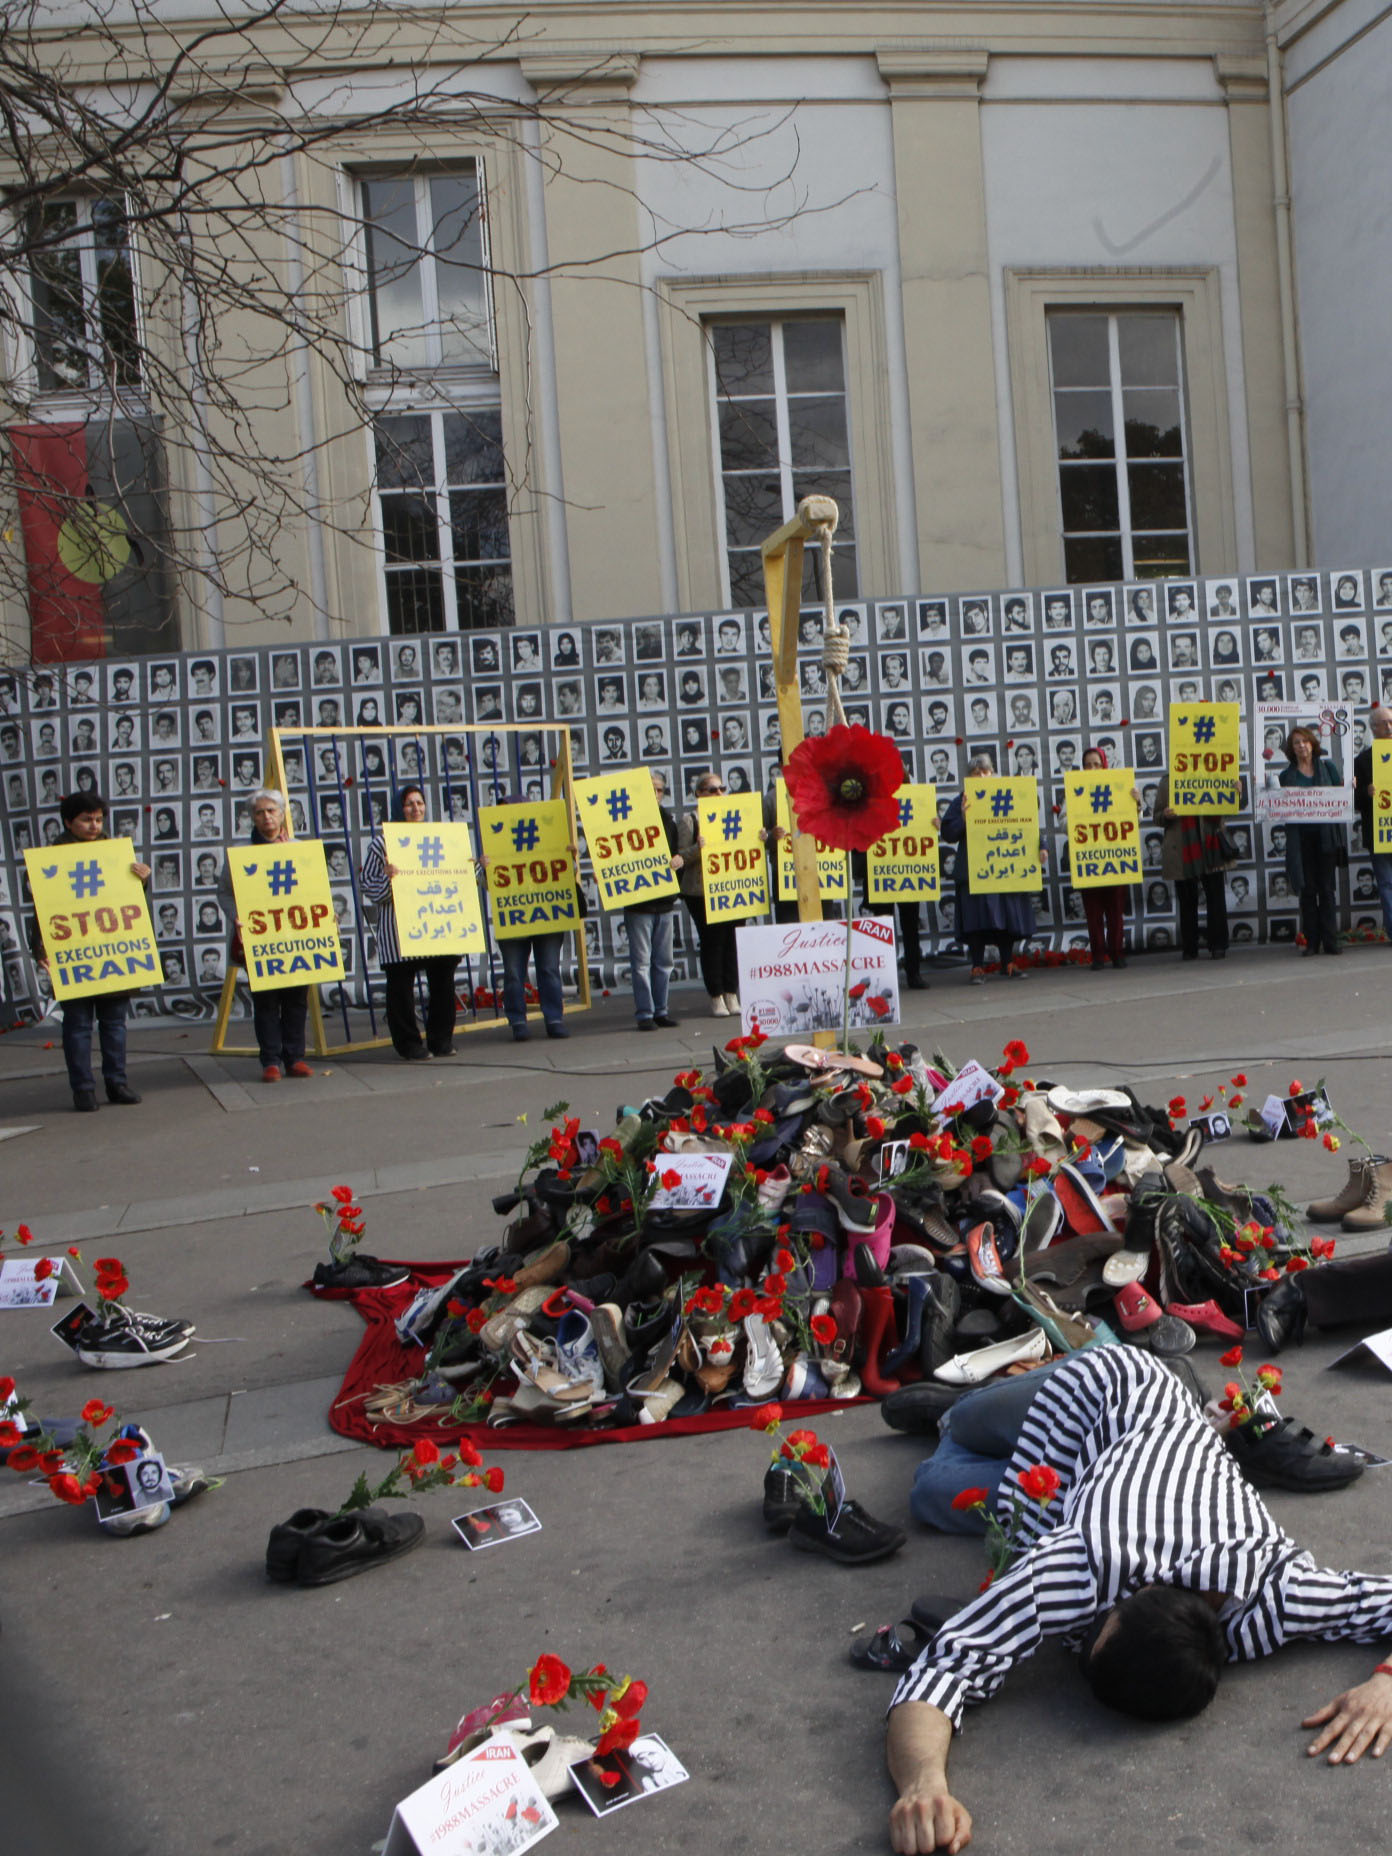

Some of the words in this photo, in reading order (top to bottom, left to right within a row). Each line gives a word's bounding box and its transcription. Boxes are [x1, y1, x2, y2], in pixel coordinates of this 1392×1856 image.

[1193, 715, 1215, 743] #
[1174, 752, 1234, 772] STOP
[605, 787, 632, 822] #
[990, 788, 1013, 817] #
[1090, 784, 1113, 813] #
[1174, 791, 1236, 805] IRAN
[511, 818, 540, 852] #
[721, 809, 742, 841] #
[987, 828, 1022, 844] توقف
[1074, 820, 1134, 844] STOP
[417, 836, 445, 868] #
[595, 825, 660, 859] STOP
[873, 836, 934, 857] STOP
[986, 845, 1025, 862] اعدام
[1075, 846, 1137, 861] EXECUTIONS
[601, 853, 670, 879] EXECUTIONS
[708, 848, 761, 874] STOP
[873, 863, 935, 875] EXECUTIONS
[977, 863, 1014, 879] ایران
[1020, 864, 1036, 878] در
[1076, 859, 1138, 877] IRAN
[68, 860, 105, 898] #
[266, 860, 298, 896] #
[493, 858, 567, 888] STOP
[604, 866, 673, 897] IRAN
[709, 875, 764, 893] EXECUTIONS
[874, 876, 936, 892] IRAN
[417, 880, 458, 898] توقف
[496, 888, 572, 908] EXECUTIONS
[710, 889, 765, 911] IRAN
[248, 904, 328, 935] STOP
[417, 900, 463, 919] اعدام
[498, 903, 574, 926] IRAN
[49, 904, 141, 940] STOP
[408, 920, 451, 939] ایران
[459, 923, 477, 937] در
[859, 920, 890, 940] IRAN
[55, 937, 150, 964] EXECUTIONS
[252, 936, 334, 957] EXECUTIONS
[777, 929, 847, 958] Justice
[59, 953, 155, 985] IRAN
[255, 951, 338, 977] IRAN
[486, 1747, 511, 1759] IRAN
